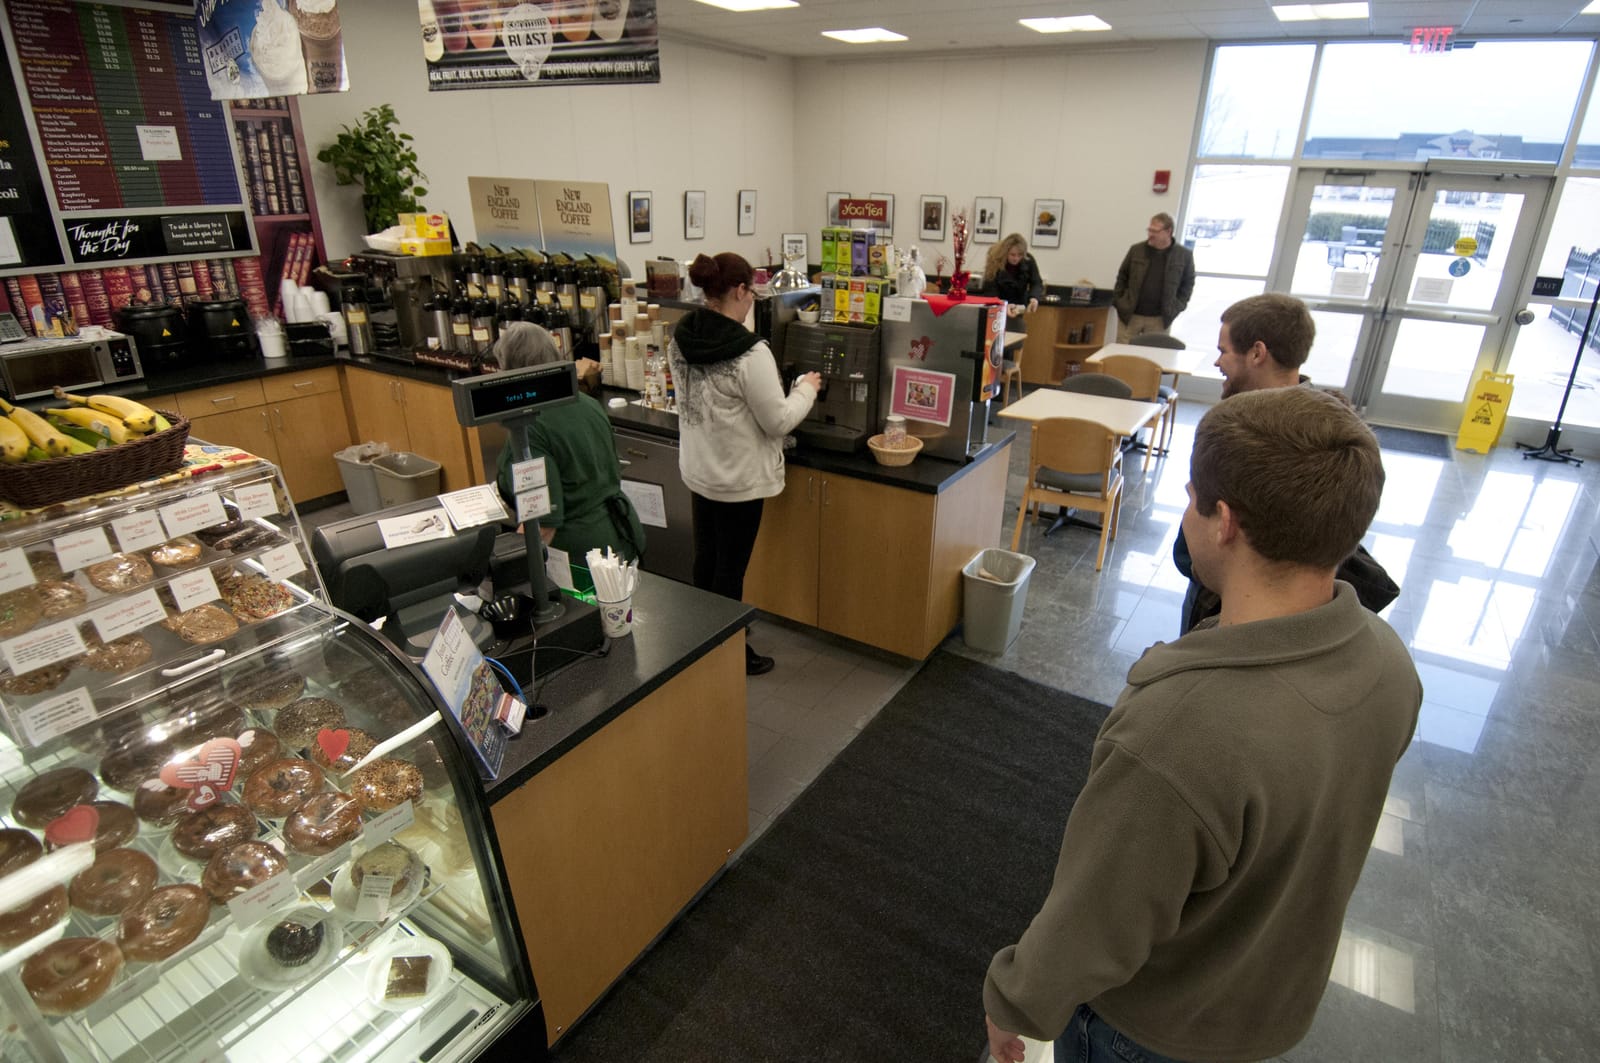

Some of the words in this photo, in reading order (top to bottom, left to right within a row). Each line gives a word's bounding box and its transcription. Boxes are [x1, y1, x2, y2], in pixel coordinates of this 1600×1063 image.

[509, 32, 548, 47] BLAST
[1409, 26, 1454, 54] EXIT
[614, 61, 635, 72] GREEN
[493, 184, 510, 197] NEW
[563, 188, 581, 201] NEW
[487, 194, 520, 209] ENGLAND
[556, 199, 592, 214] ENGLAND
[491, 207, 520, 221] COFFEE
[841, 202, 865, 216] YOGI
[865, 203, 883, 217] TEA
[178, 222, 188, 230] add
[561, 212, 592, 226] COFFEE
[68, 222, 118, 240] Thought
[122, 219, 140, 239] for
[79, 241, 99, 256] the
[100, 237, 131, 257] Day
[1536, 282, 1558, 290] EXIT
[506, 393, 523, 402] Total
[522, 494, 544, 505] Pumpkin
